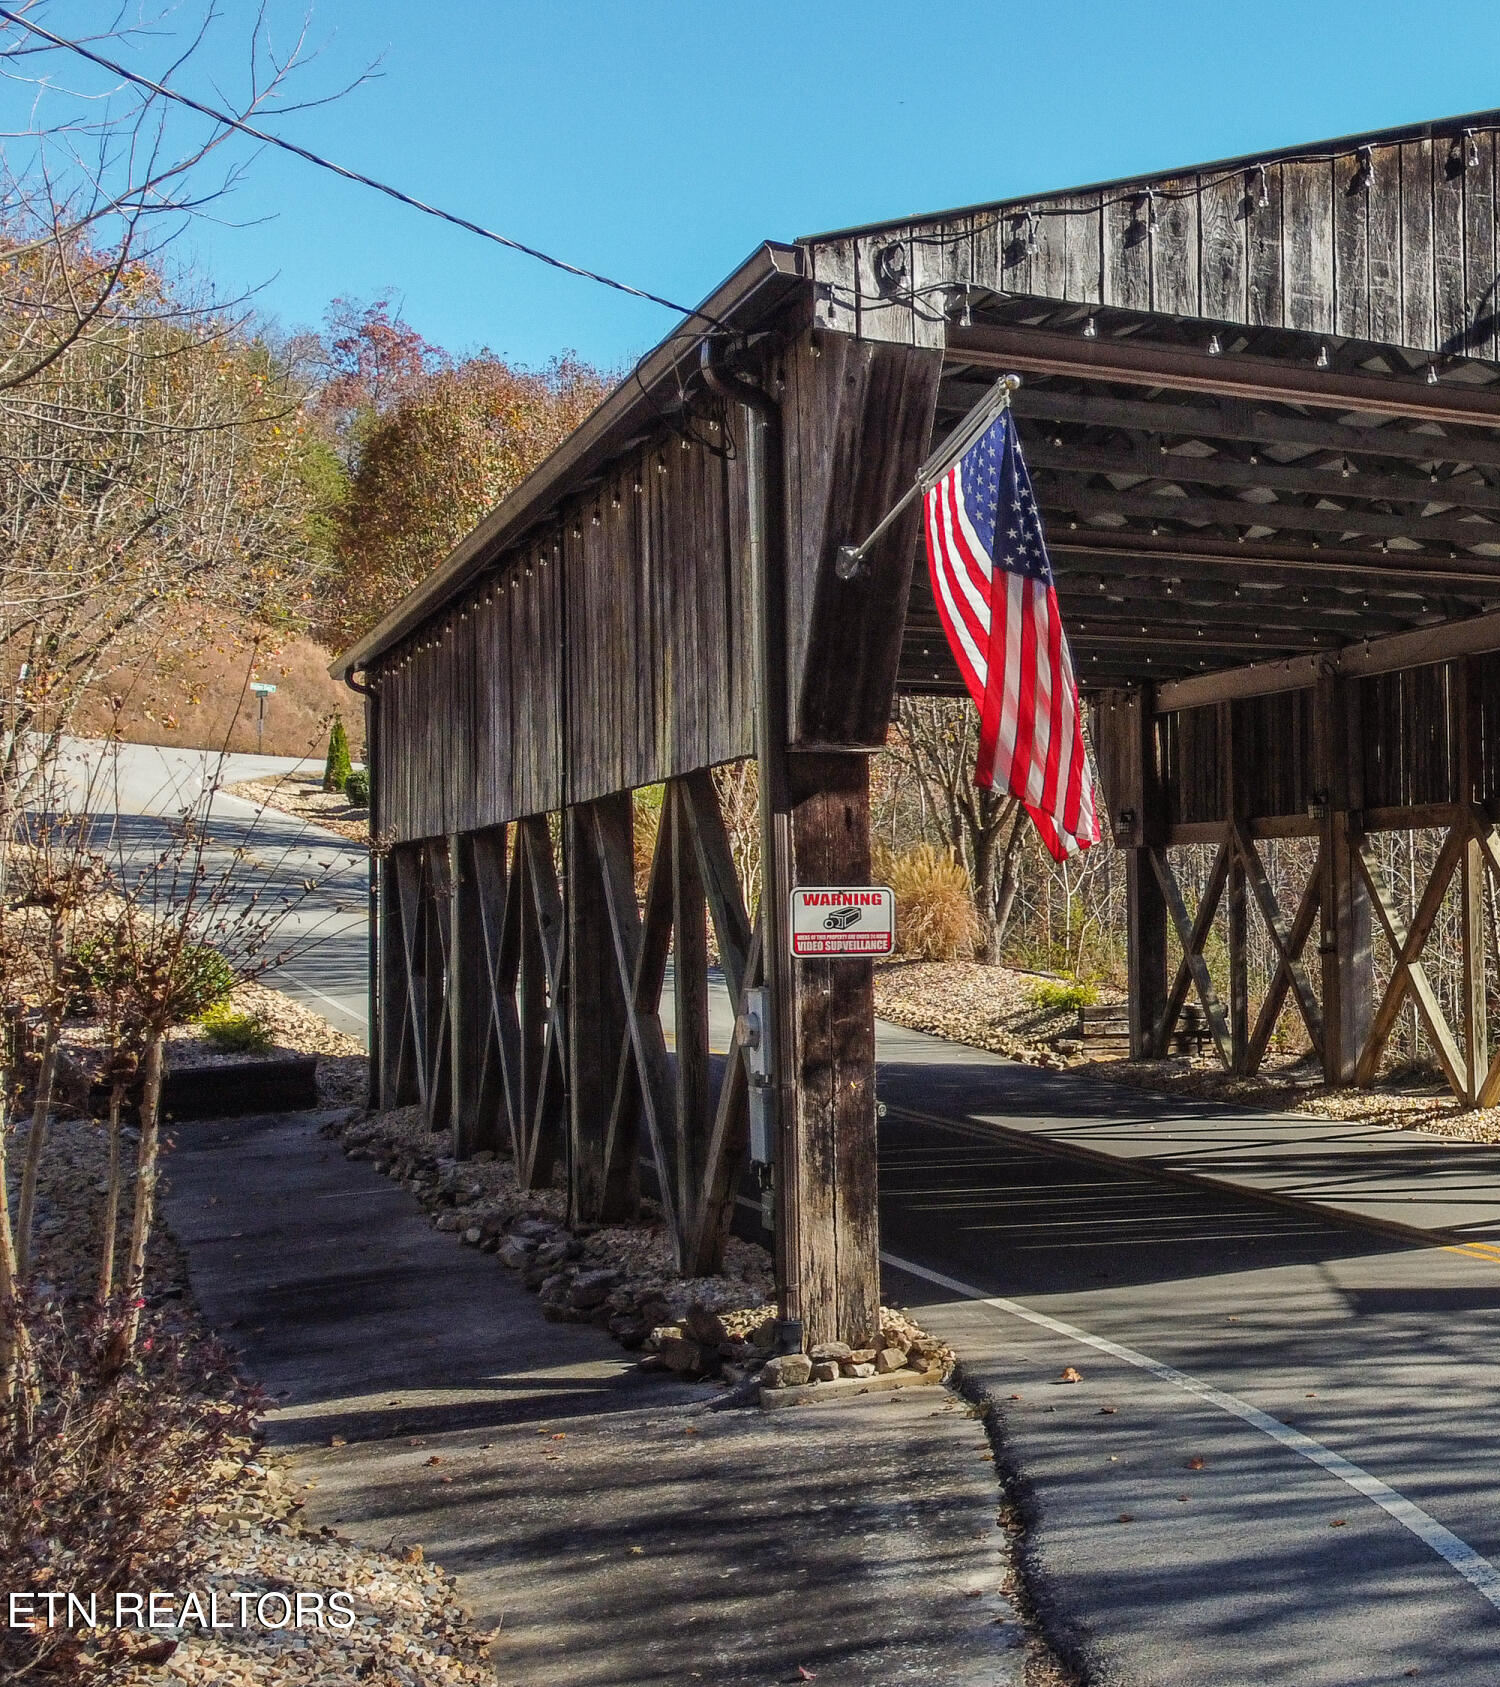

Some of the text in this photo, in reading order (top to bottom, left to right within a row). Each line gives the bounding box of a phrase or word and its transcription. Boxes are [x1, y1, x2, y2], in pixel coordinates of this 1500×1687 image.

[803, 893, 882, 906] WARNING
[798, 940, 888, 951] VIDEO SURVEILLANCE
